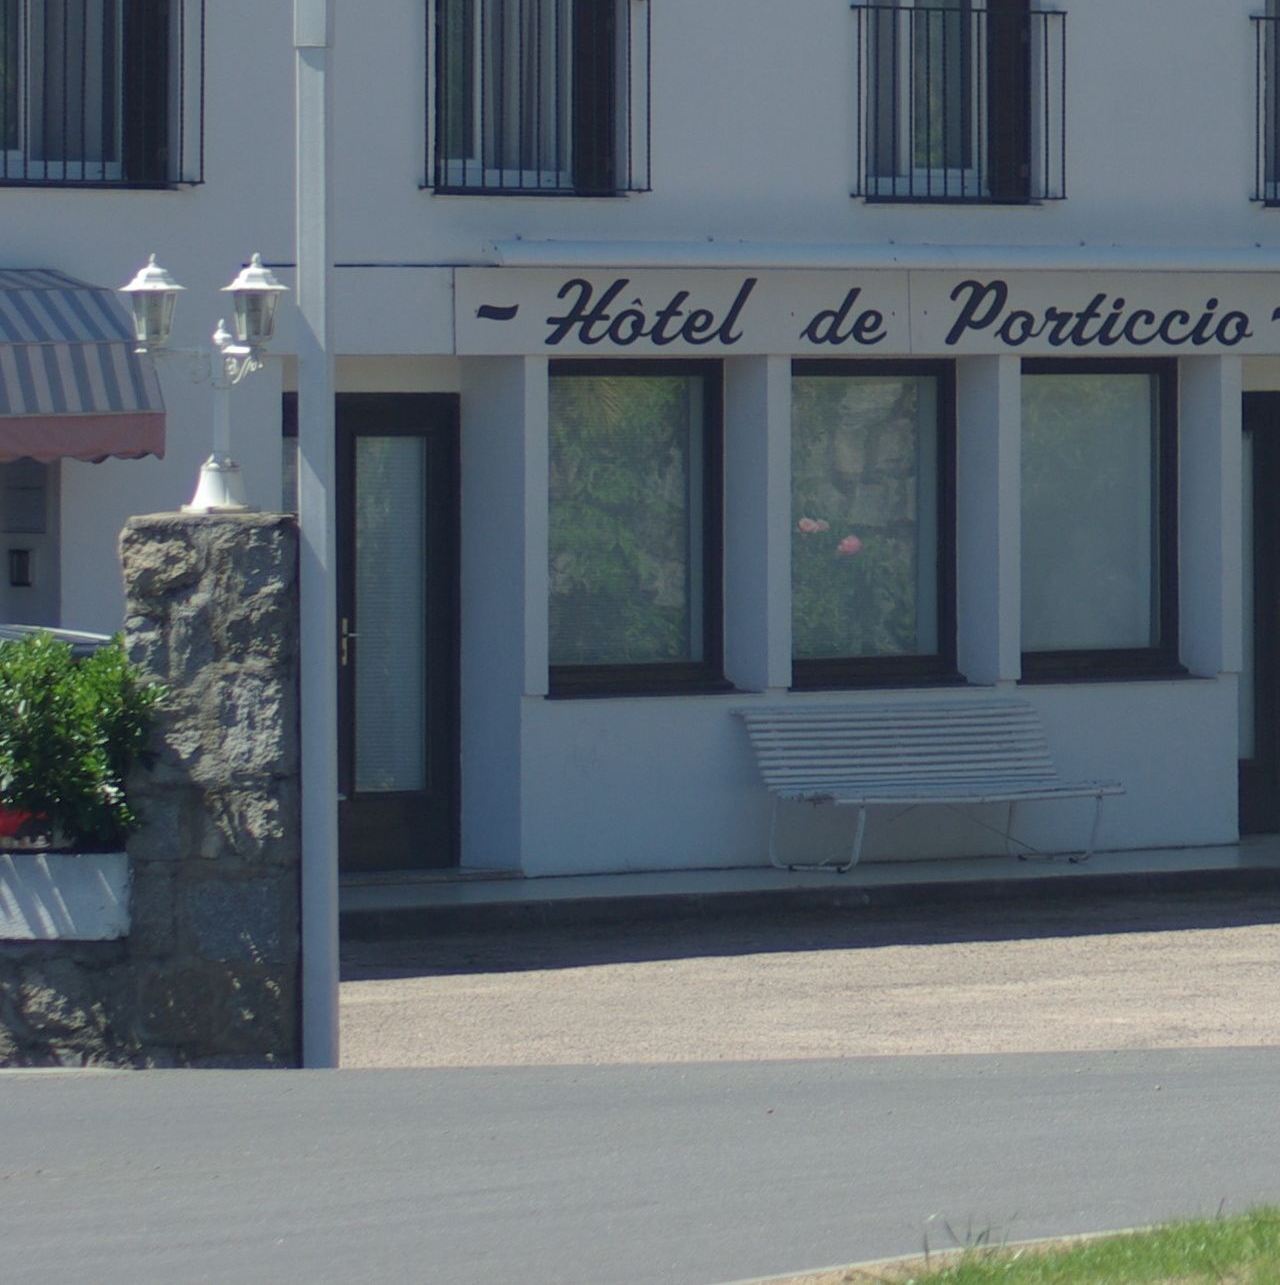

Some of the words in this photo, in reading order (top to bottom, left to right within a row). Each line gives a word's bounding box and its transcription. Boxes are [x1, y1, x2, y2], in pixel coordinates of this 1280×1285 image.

[544, 277, 758, 346] Hôtel
[799, 287, 888, 346] de
[944, 279, 1254, 347] Porticcio
